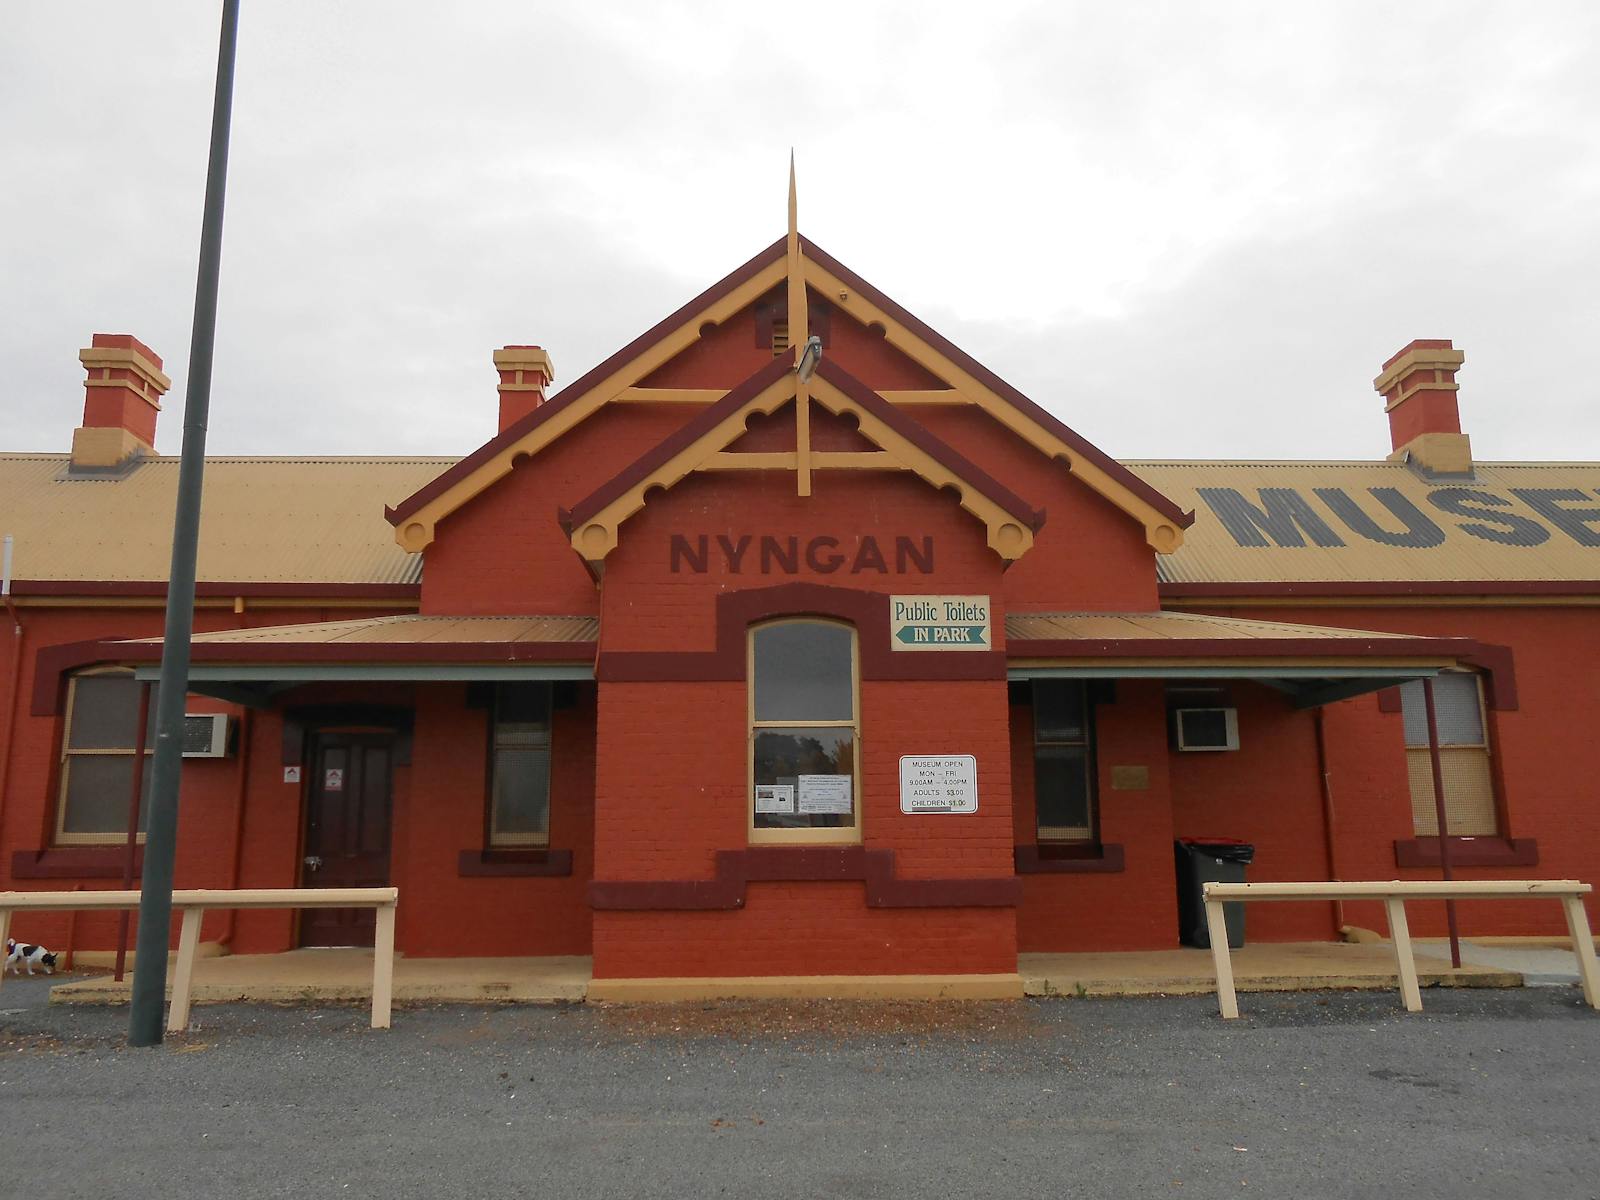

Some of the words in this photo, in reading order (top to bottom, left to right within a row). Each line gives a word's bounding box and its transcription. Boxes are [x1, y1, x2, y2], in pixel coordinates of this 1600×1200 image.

[670, 534, 934, 575] NYNGAN
[895, 601, 938, 621] Public
[943, 602, 986, 621] Toilets
[913, 627, 929, 642] IN
[934, 627, 971, 642] PARK
